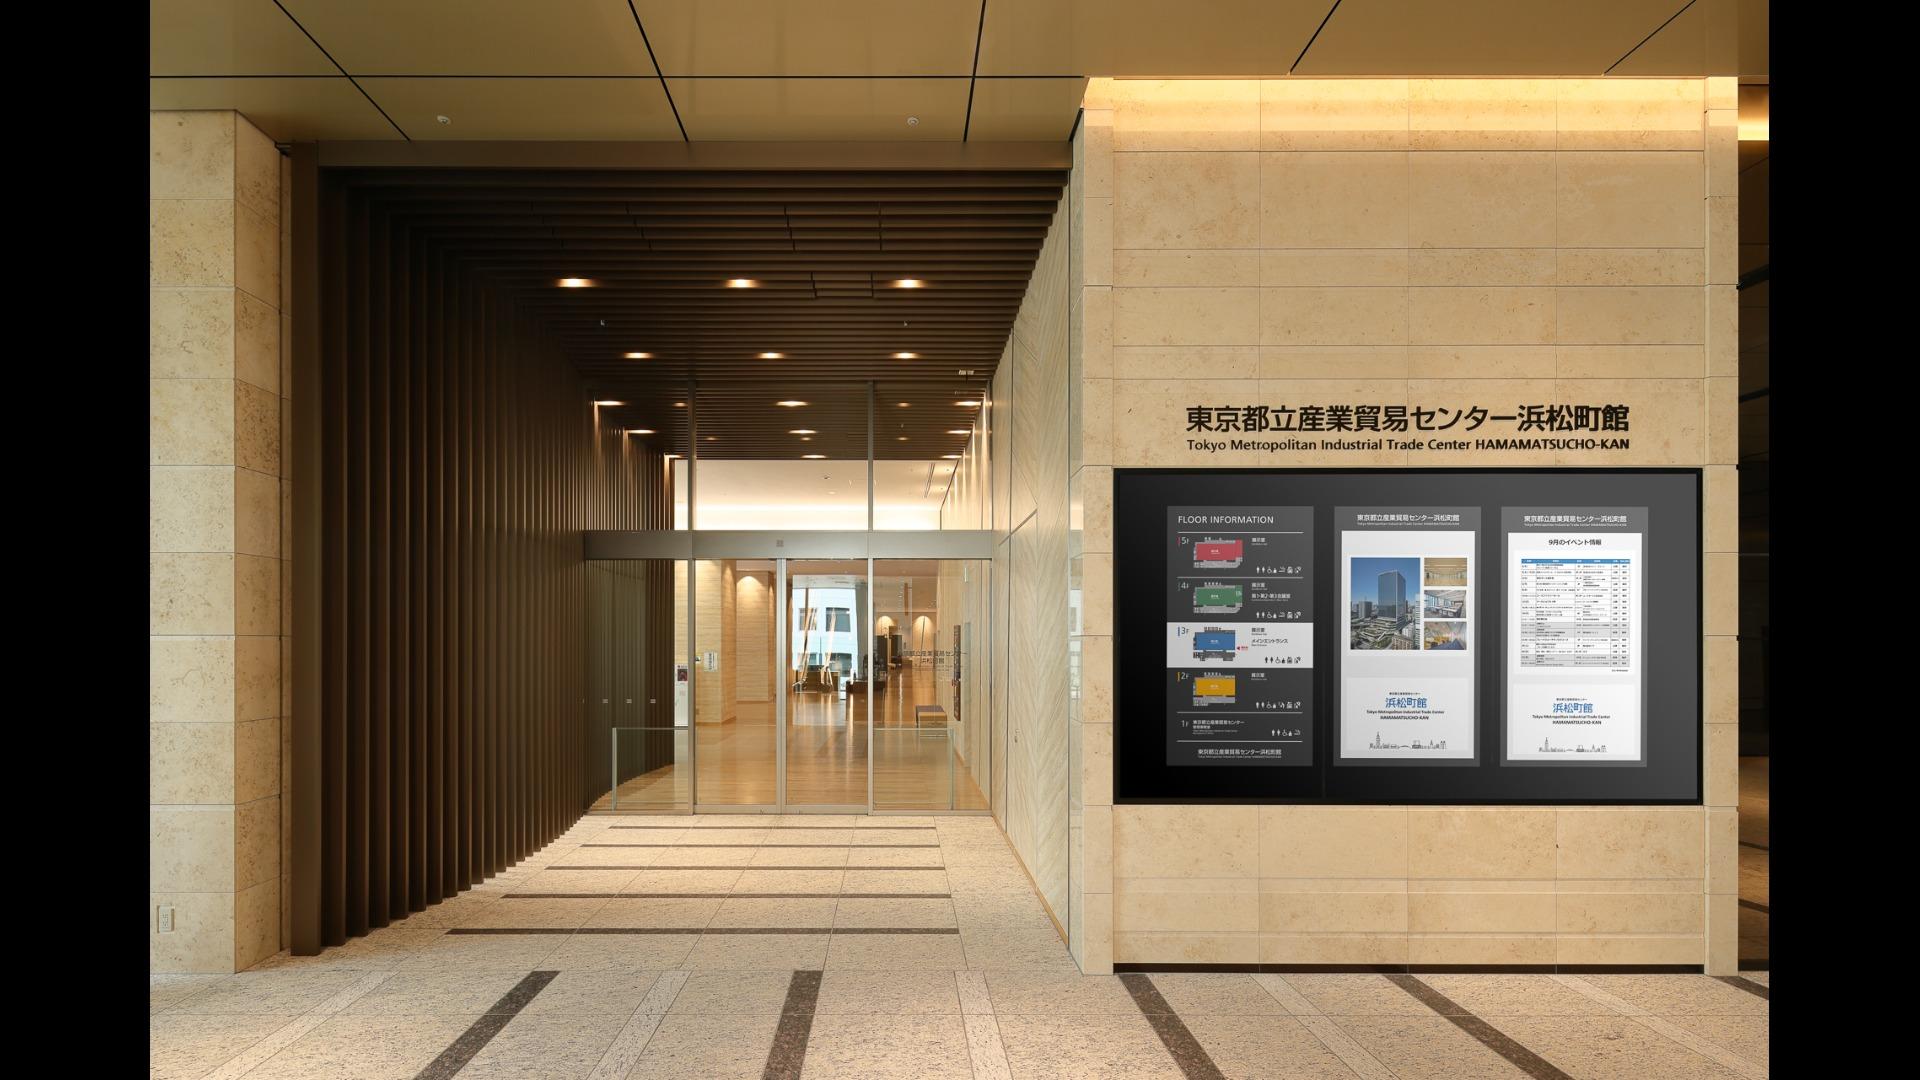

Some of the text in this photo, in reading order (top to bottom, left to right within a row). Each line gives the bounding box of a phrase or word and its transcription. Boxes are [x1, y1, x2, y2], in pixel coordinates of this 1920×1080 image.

[1186, 404, 1630, 432] 東京都立産業貿易センター浜松町館
[1187, 438, 1630, 453] Tokyo Metropolitan Industrial Trade Center HAMAMATSUCHO-KAN
[1178, 515, 1274, 524] FLOOR INFORMATION
[1385, 697, 1427, 708] 浜松町館
[1553, 702, 1593, 713] 浜松町館
